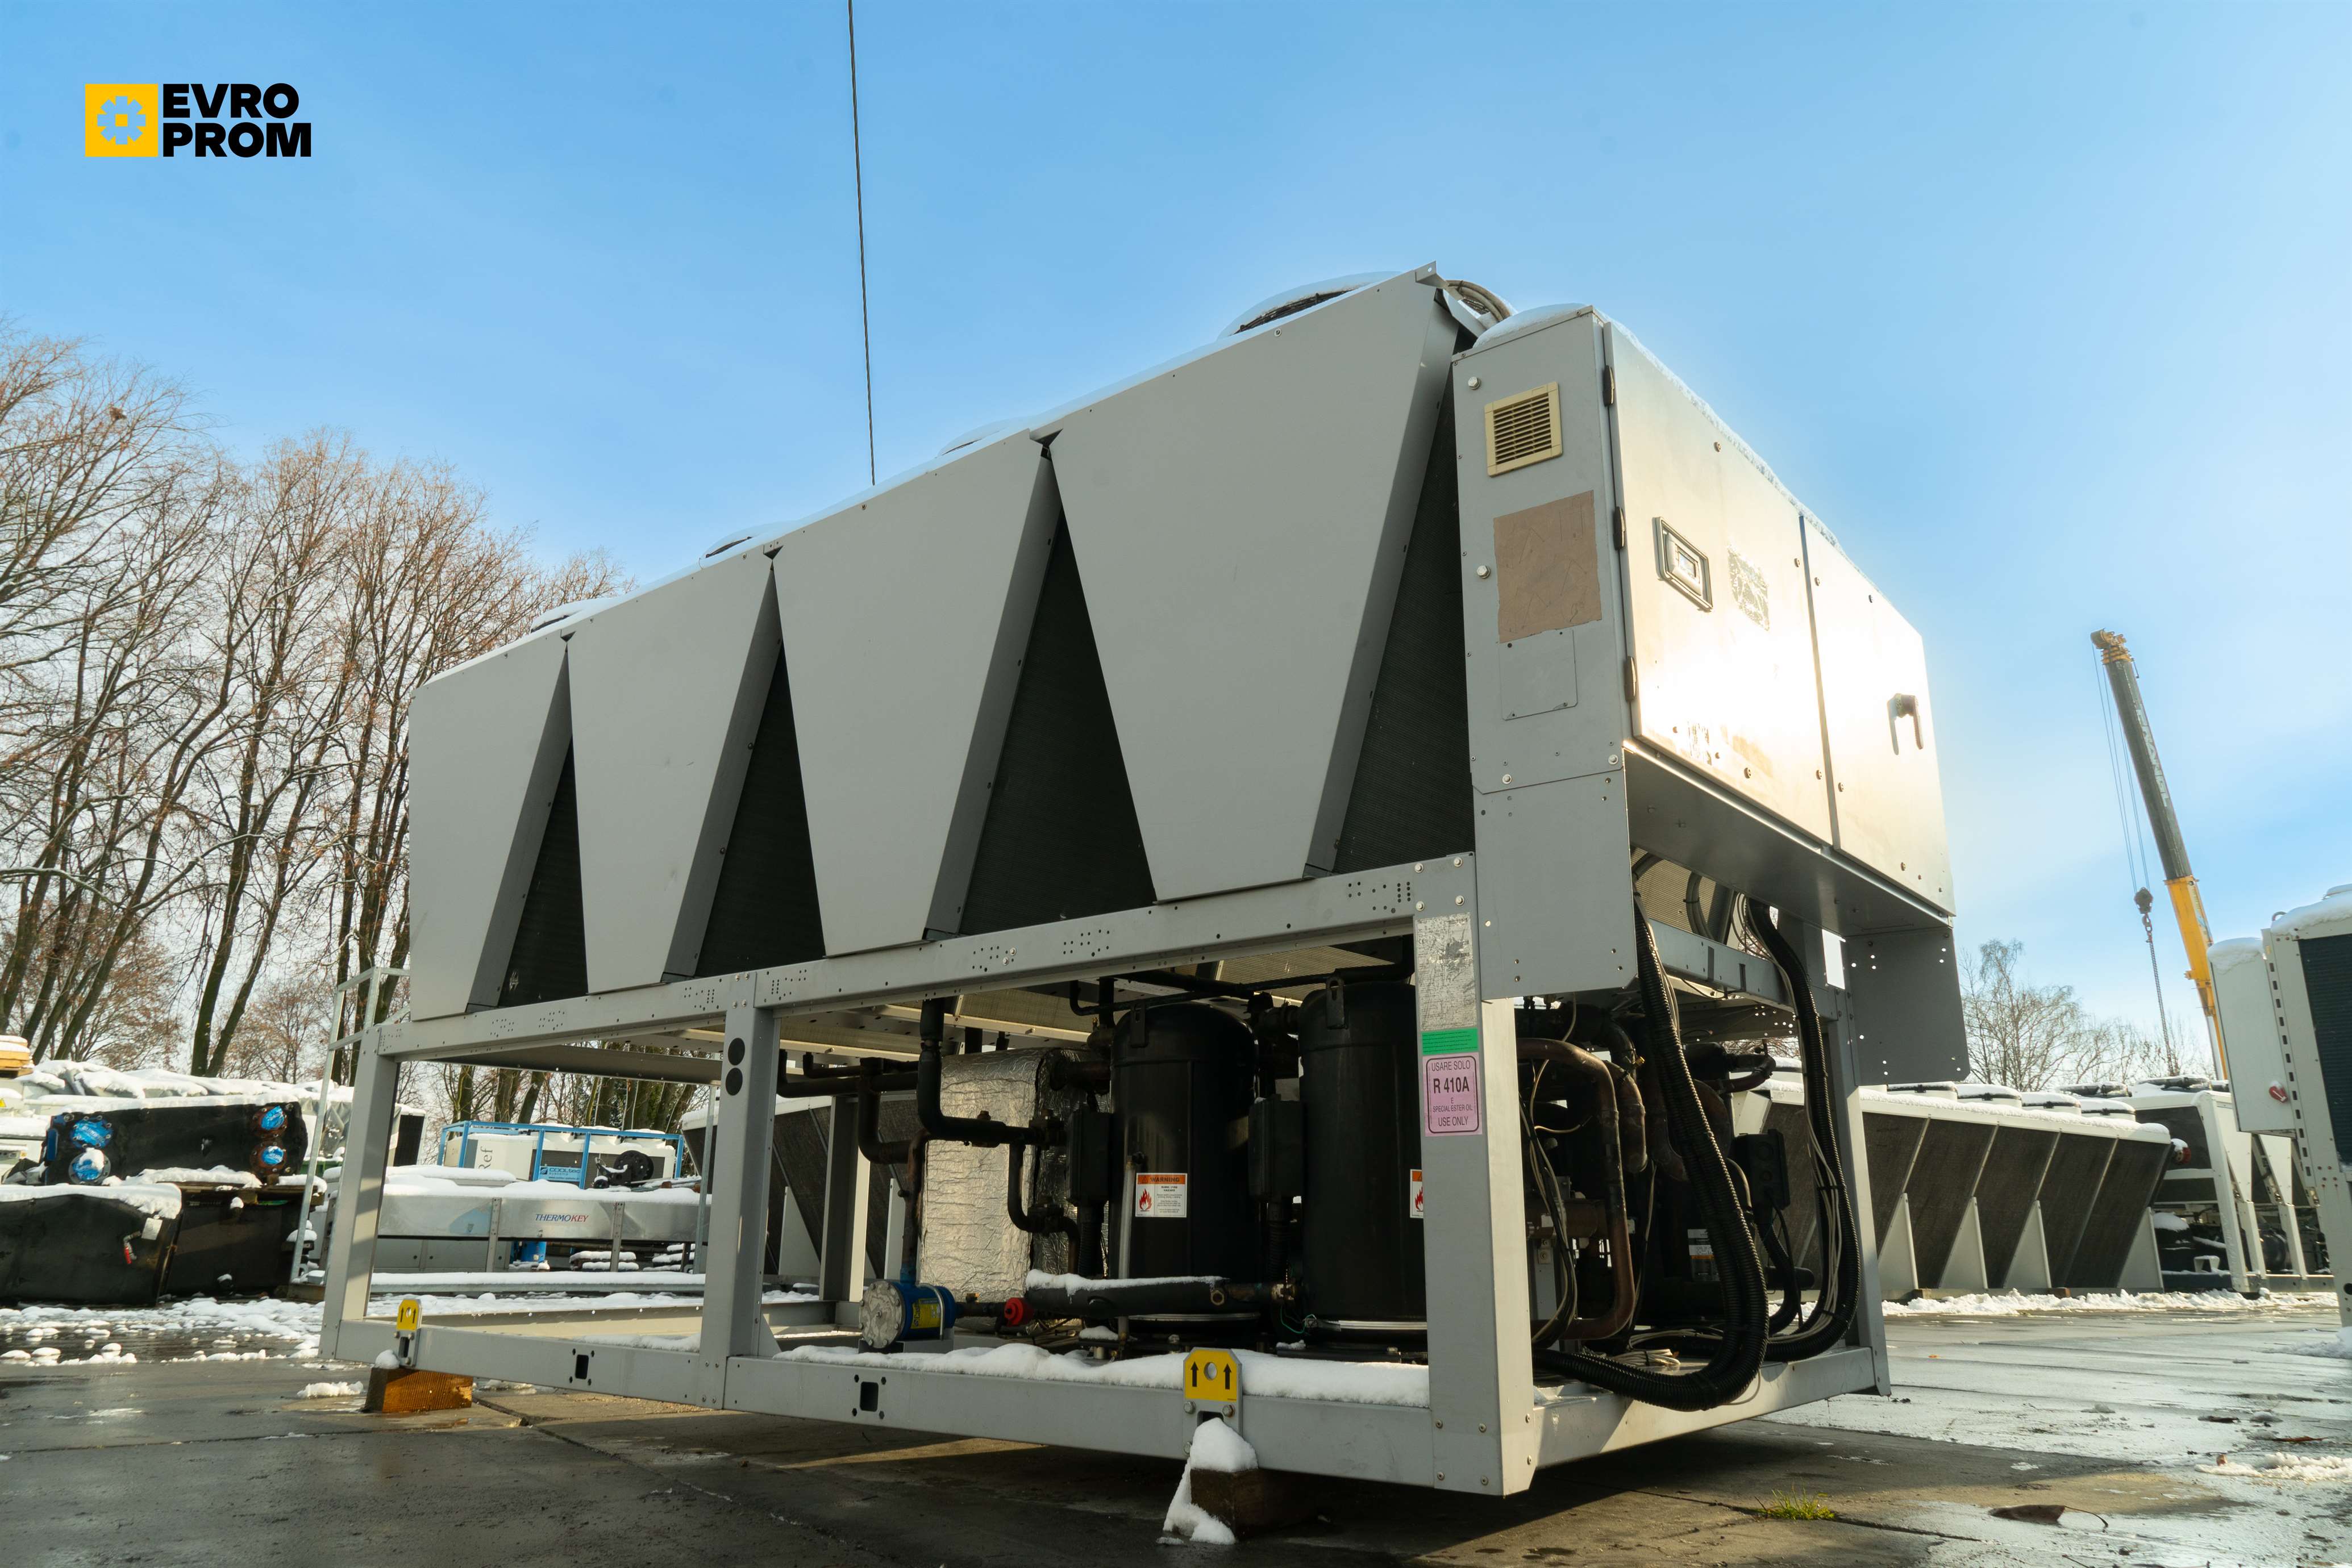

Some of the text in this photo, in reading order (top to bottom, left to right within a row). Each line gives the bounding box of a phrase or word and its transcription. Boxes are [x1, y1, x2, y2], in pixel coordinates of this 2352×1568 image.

[1432, 1060, 1471, 1071] USARE SOLO
[1433, 1077, 1470, 1094] R 410A
[1438, 1116, 1468, 1127] USE ONLY
[535, 1213, 589, 1222] THERMOKEY
